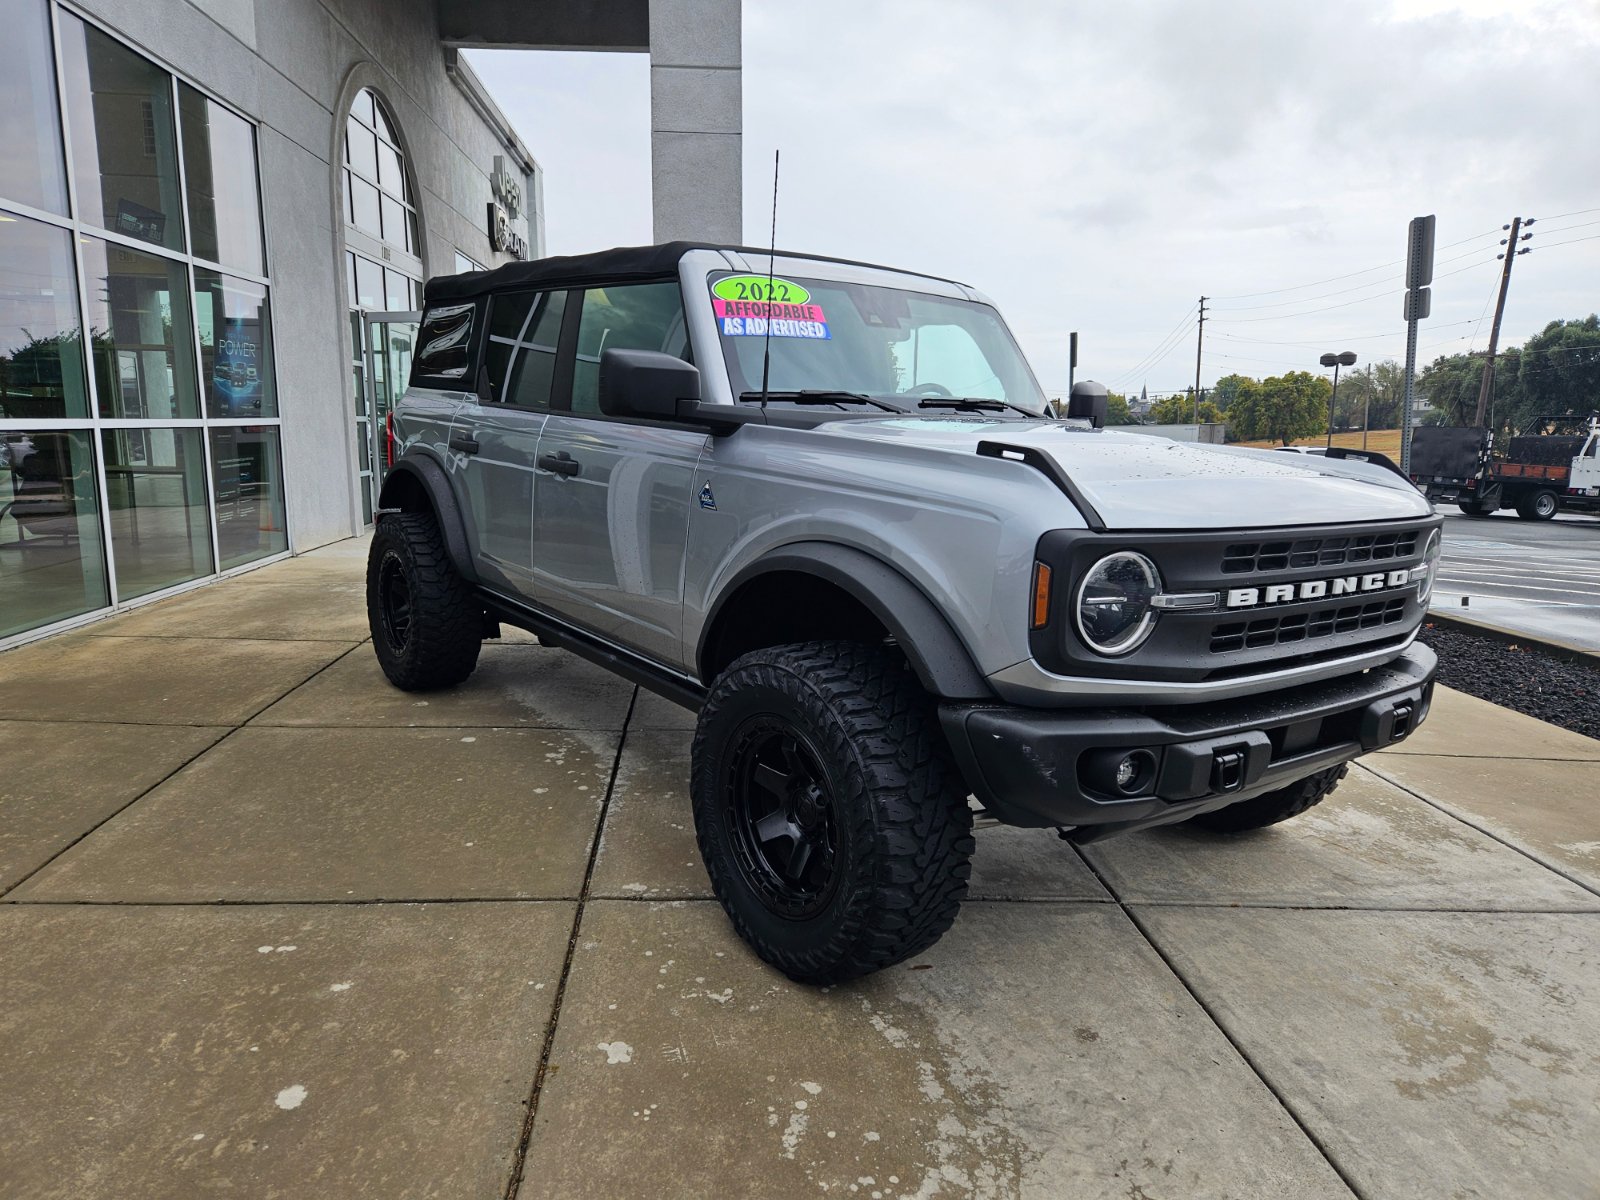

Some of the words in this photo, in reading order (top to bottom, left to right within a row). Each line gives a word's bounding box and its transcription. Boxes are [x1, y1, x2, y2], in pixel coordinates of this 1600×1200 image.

[504, 224, 528, 261] RAM
[735, 282, 791, 302] 2022
[725, 302, 815, 320] AFFORDABLE
[724, 317, 745, 336] AS
[745, 318, 827, 338] ADVERTISED
[219, 339, 256, 358] POWER
[1227, 569, 1409, 608] BRONCO
